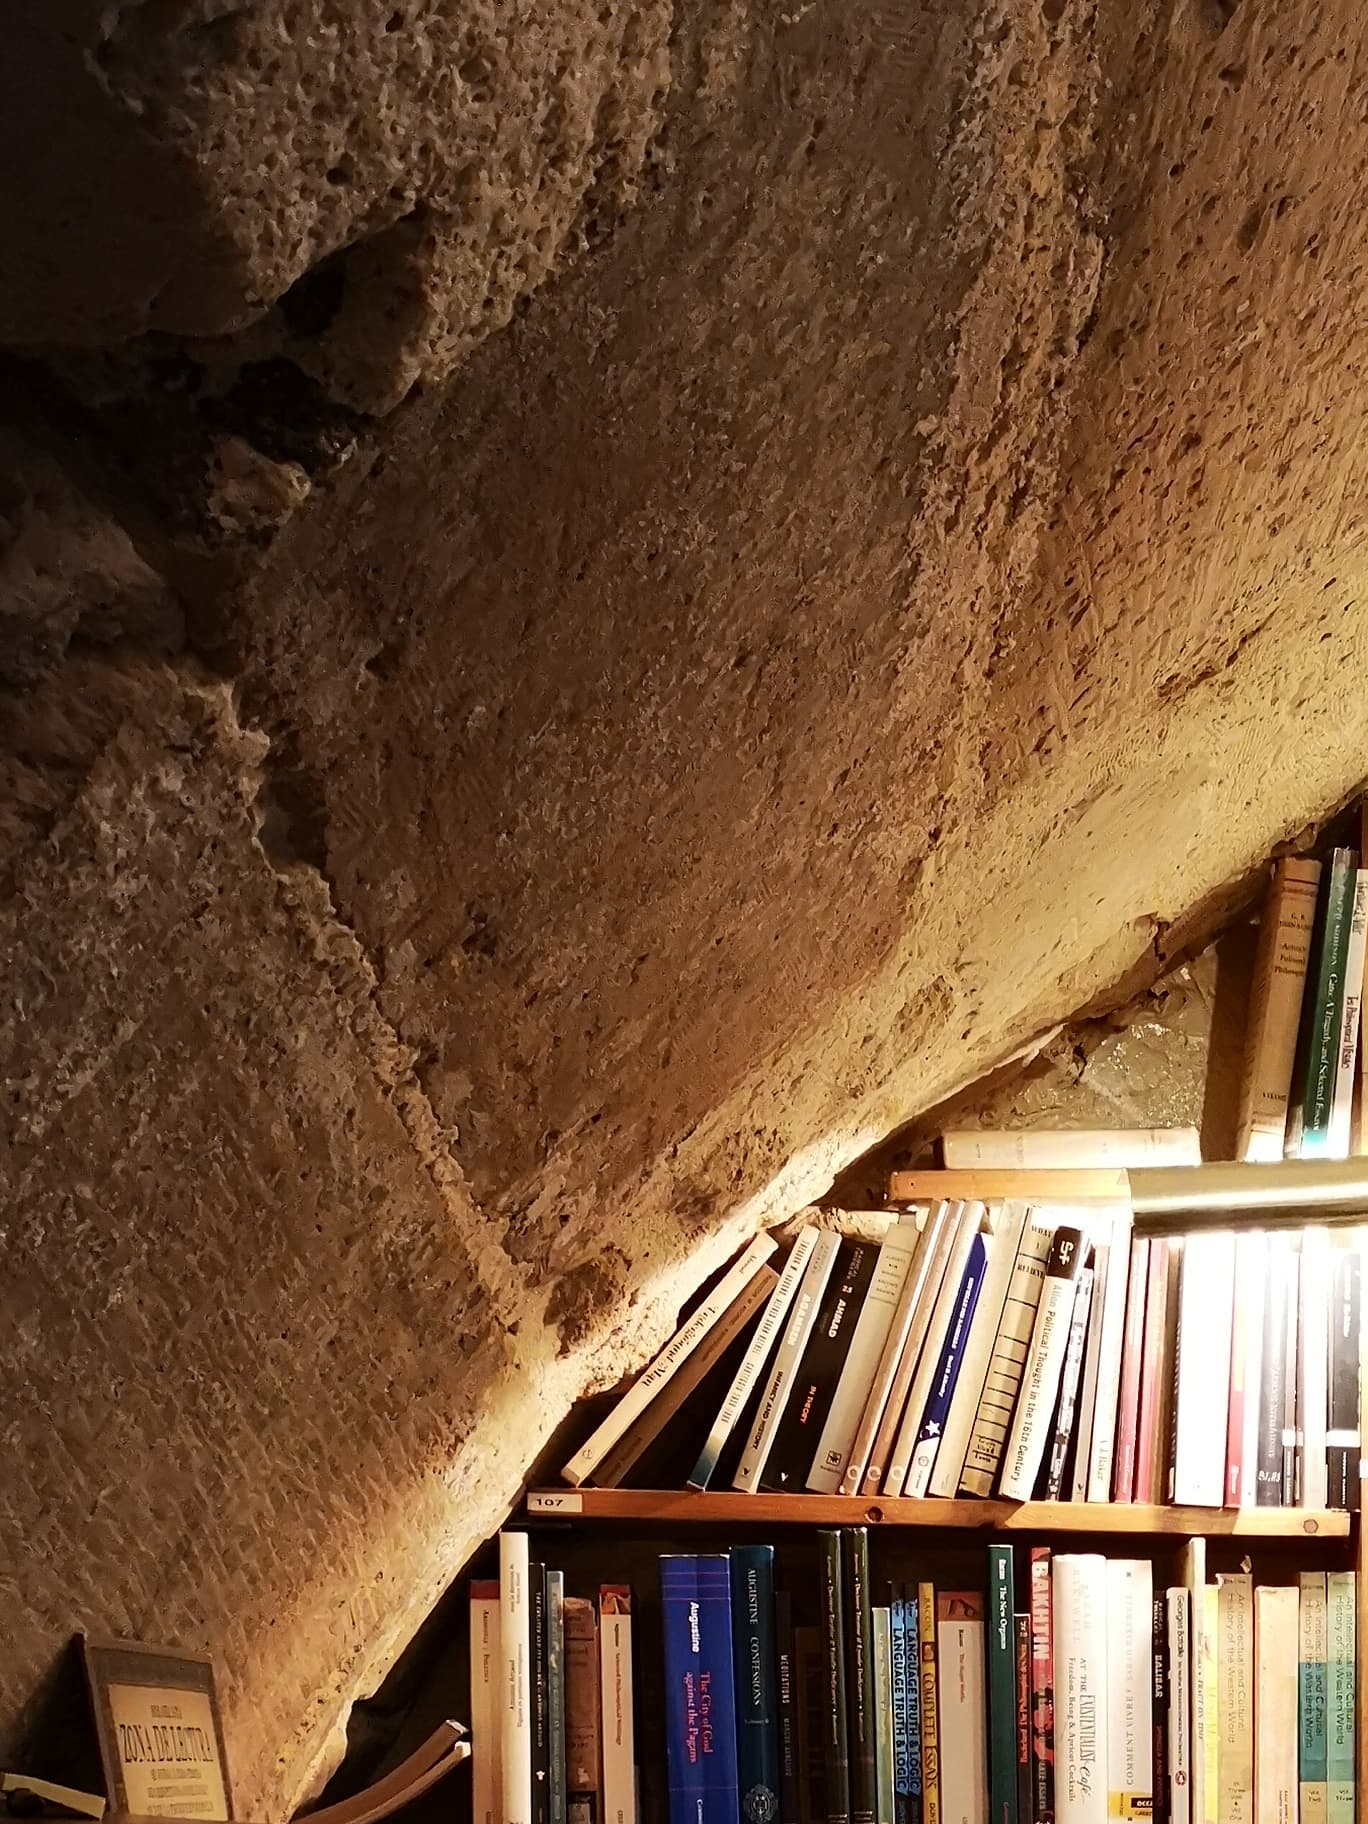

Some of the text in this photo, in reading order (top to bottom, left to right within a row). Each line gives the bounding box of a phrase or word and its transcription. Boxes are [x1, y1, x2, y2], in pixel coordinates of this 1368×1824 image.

[828, 1299, 847, 1338] AHMAD
[1039, 1310, 1057, 1349] Political
[1032, 1351, 1048, 1387] Thought
[1026, 1402, 1038, 1417] the
[1011, 1445, 1028, 1482] Century
[688, 1602, 701, 1653] Augustine
[1032, 1560, 1050, 1660] BAKHTIN
[684, 1671, 700, 1763] against the Pagans
[699, 1671, 713, 1753] The City of God
[907, 1628, 920, 1789] LANGUAGE TRUTH & LOGIC
